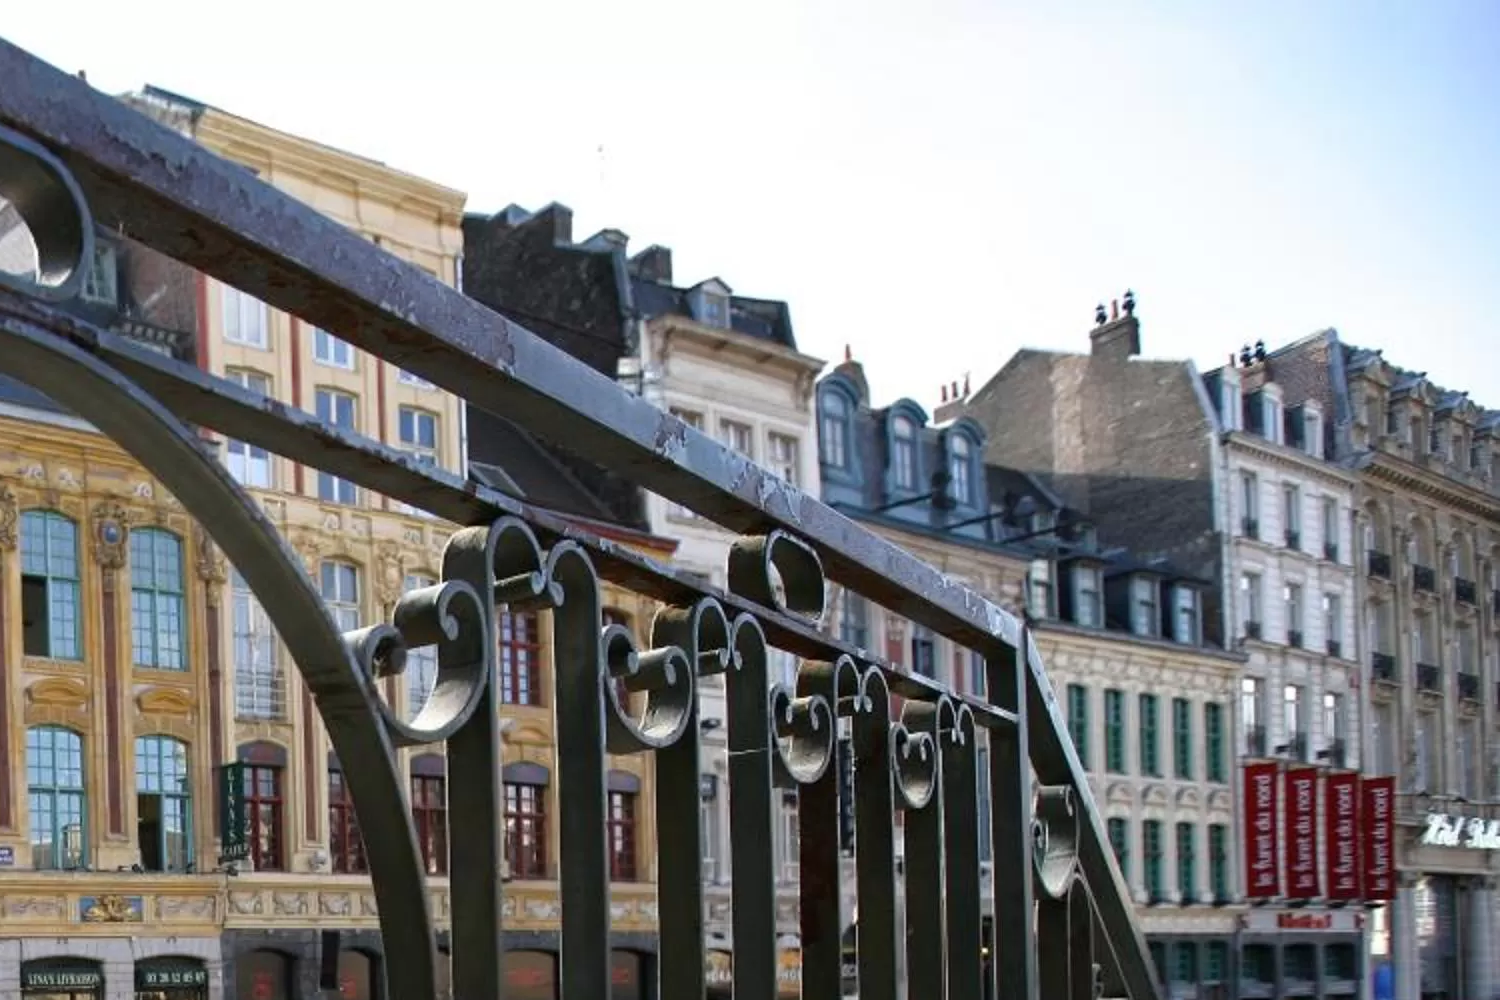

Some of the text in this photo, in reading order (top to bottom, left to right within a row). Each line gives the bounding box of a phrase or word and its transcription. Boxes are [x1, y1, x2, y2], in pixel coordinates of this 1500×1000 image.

[1252, 775, 1273, 887] le furet du nord
[1292, 779, 1314, 888] le furet du nord
[1332, 784, 1354, 889] le furet du nord
[1368, 787, 1389, 891] le furet du nord
